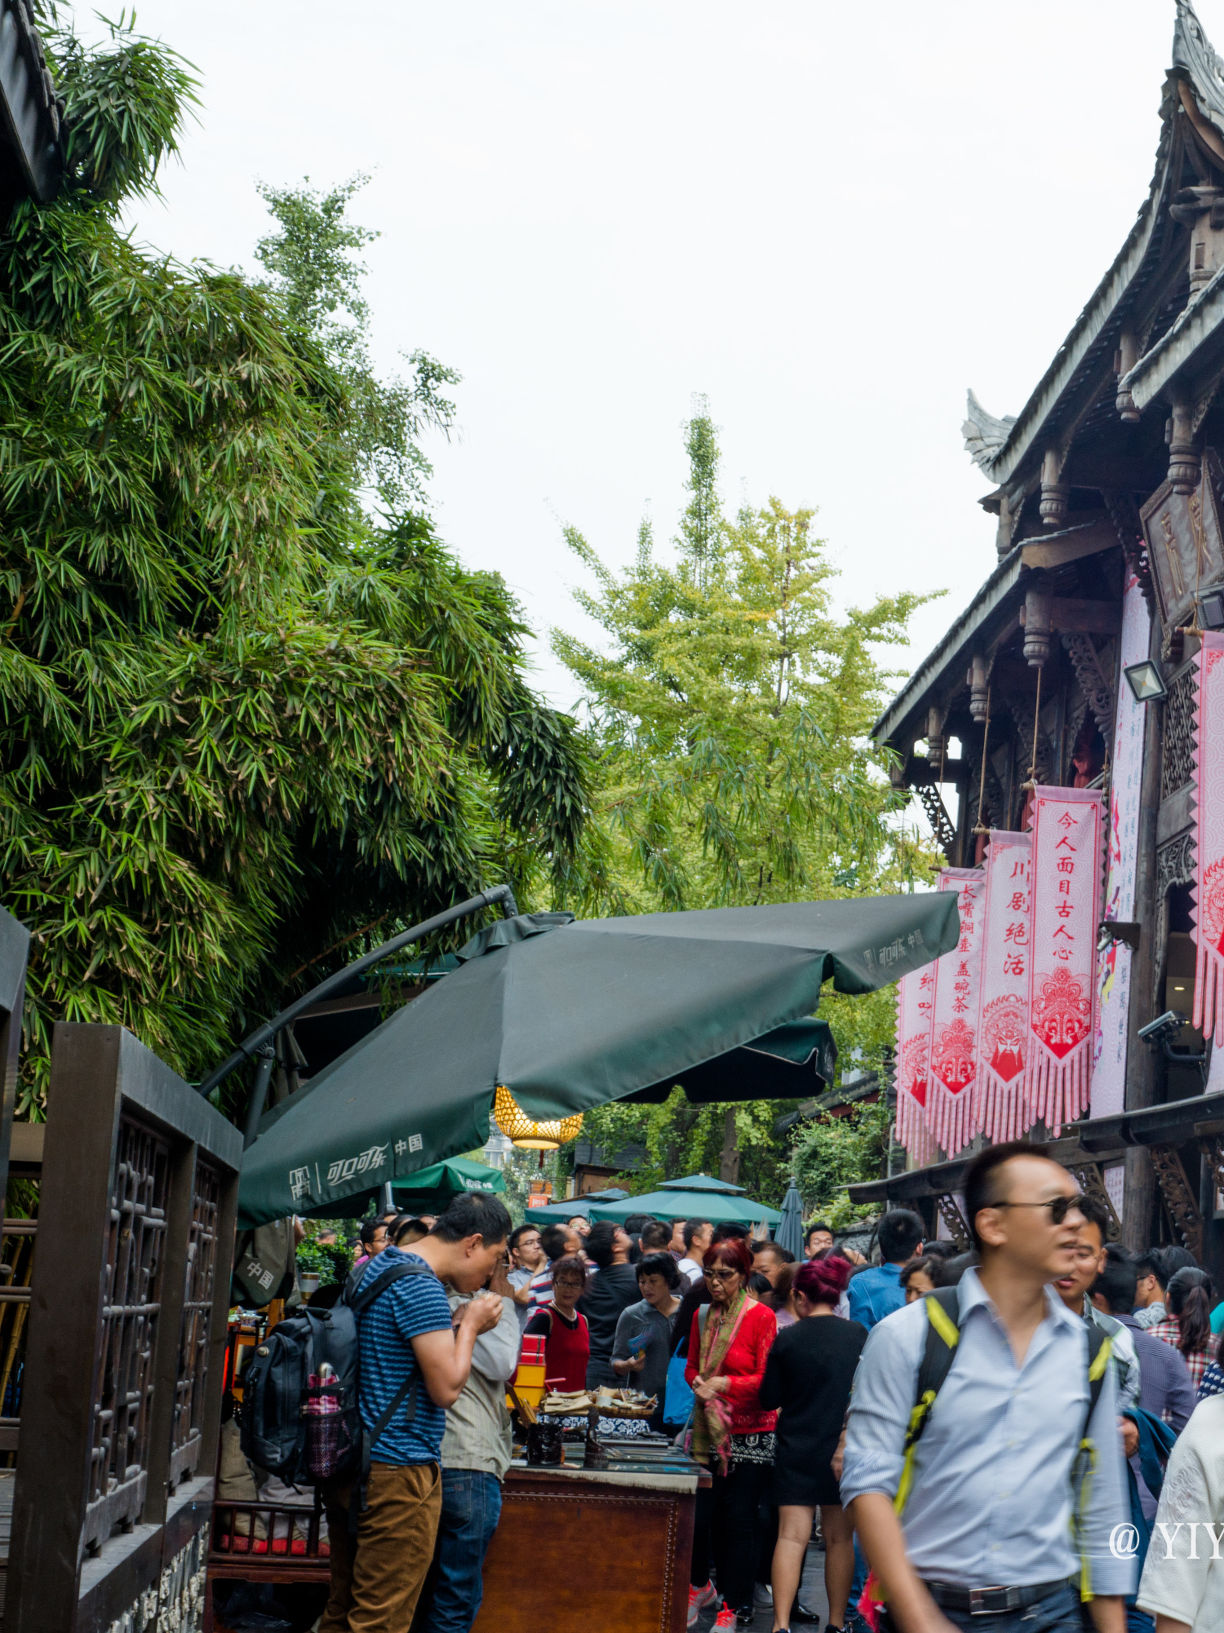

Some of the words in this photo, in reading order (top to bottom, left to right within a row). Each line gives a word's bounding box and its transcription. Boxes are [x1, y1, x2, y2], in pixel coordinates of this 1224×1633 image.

[1052, 811, 1079, 961] 今人面目古人心
[957, 883, 977, 953] 长嘴铜壶
[1002, 859, 1031, 977] 川剧绝活
[952, 960, 971, 1014] 盖碗茶
[327, 1142, 390, 1187] 可口可乐
[394, 1133, 423, 1156] 中国
[247, 1262, 274, 1290] 中国
